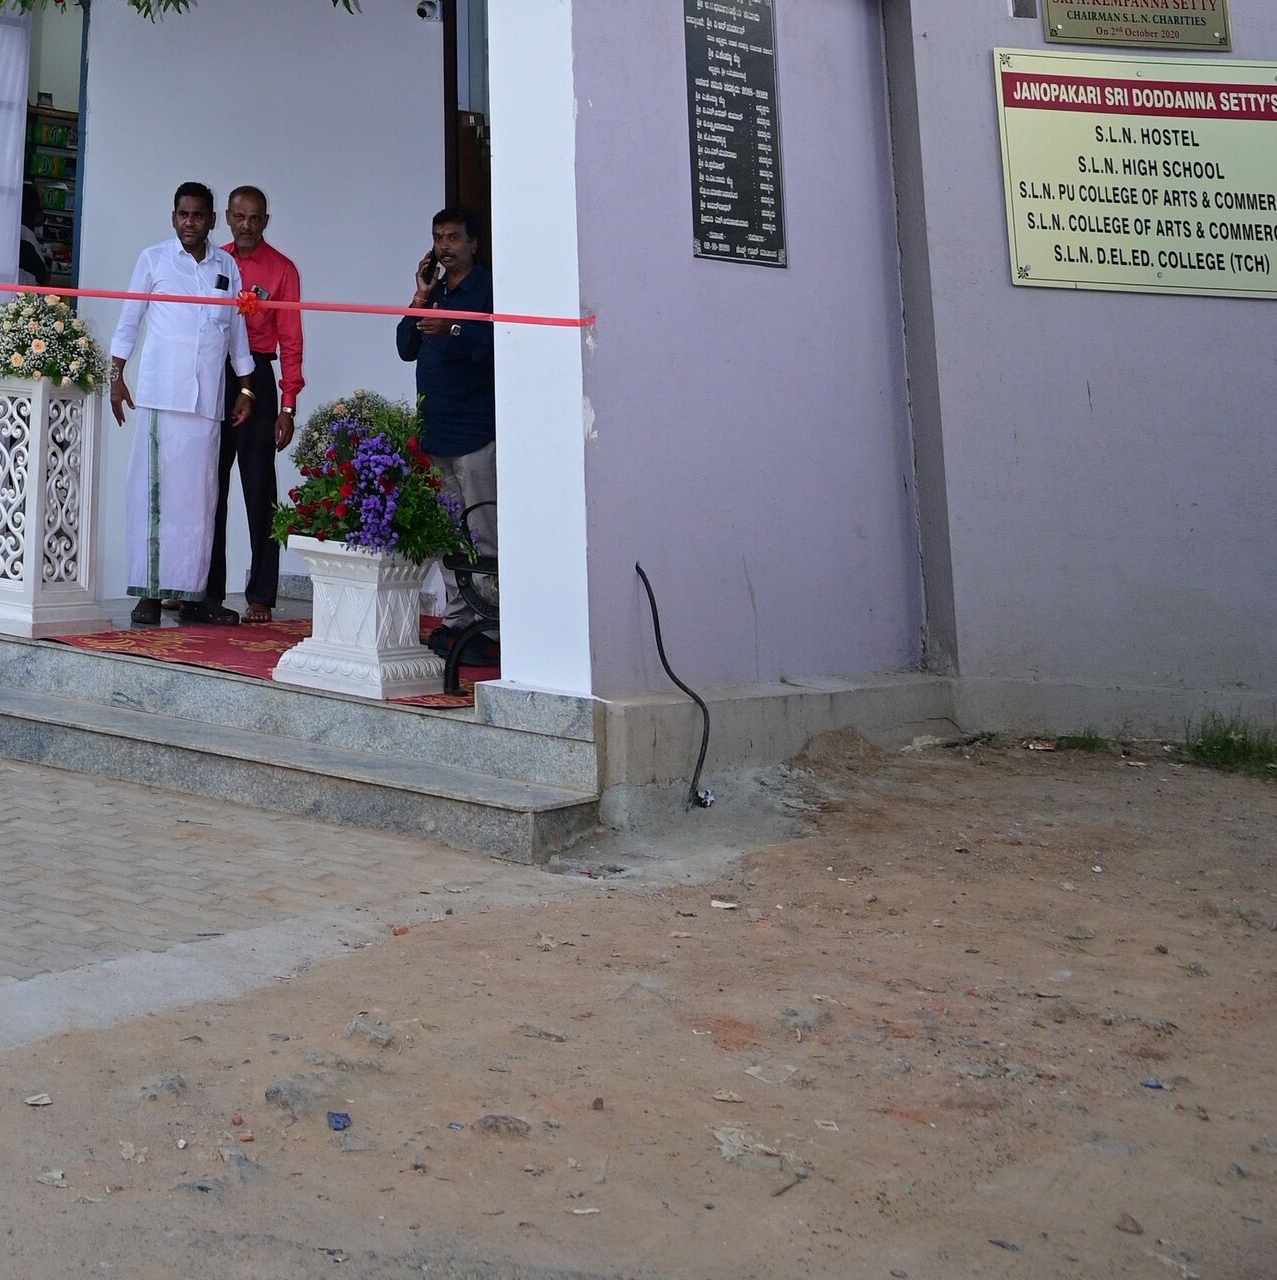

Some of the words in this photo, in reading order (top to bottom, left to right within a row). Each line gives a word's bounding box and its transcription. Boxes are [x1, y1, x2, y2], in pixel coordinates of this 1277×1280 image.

[1067, 11, 1120, 22] CHAIRMAN
[1123, 14, 1150, 23] S.L.N.
[1153, 16, 1206, 26] CHARITIES
[1096, 27, 1108, 35] On
[1125, 28, 1158, 38] October
[1161, 30, 1179, 39] 2020
[1014, 82, 1101, 105] JANOPAKARI
[1105, 88, 1128, 106] SRI
[1133, 89, 1216, 110] DODDANNA
[1095, 125, 1136, 144] S.L.N.
[1141, 128, 1199, 147] HOSTEL
[1078, 156, 1118, 174] S.L.N.
[1123, 158, 1157, 177] HIGH
[1163, 161, 1224, 179] SCHOOL
[1020, 181, 1054, 199] S.L.N.
[1059, 184, 1074, 201] PU
[1079, 185, 1138, 204] COLLEGE
[1142, 189, 1158, 205] OF
[1164, 190, 1197, 207] ARTS
[1202, 192, 1210, 208] &
[1028, 212, 1064, 231] S.L.N.
[1069, 215, 1130, 234] COLLEGE
[1134, 218, 1151, 235] OF
[1156, 220, 1191, 238] ARTS
[1197, 221, 1205, 238] &
[1054, 245, 1092, 264] S.L.N.
[1097, 248, 1153, 267] D.EL.ED.
[1158, 251, 1225, 270] COLLEGE
[1230, 253, 1270, 275] (TCH)
